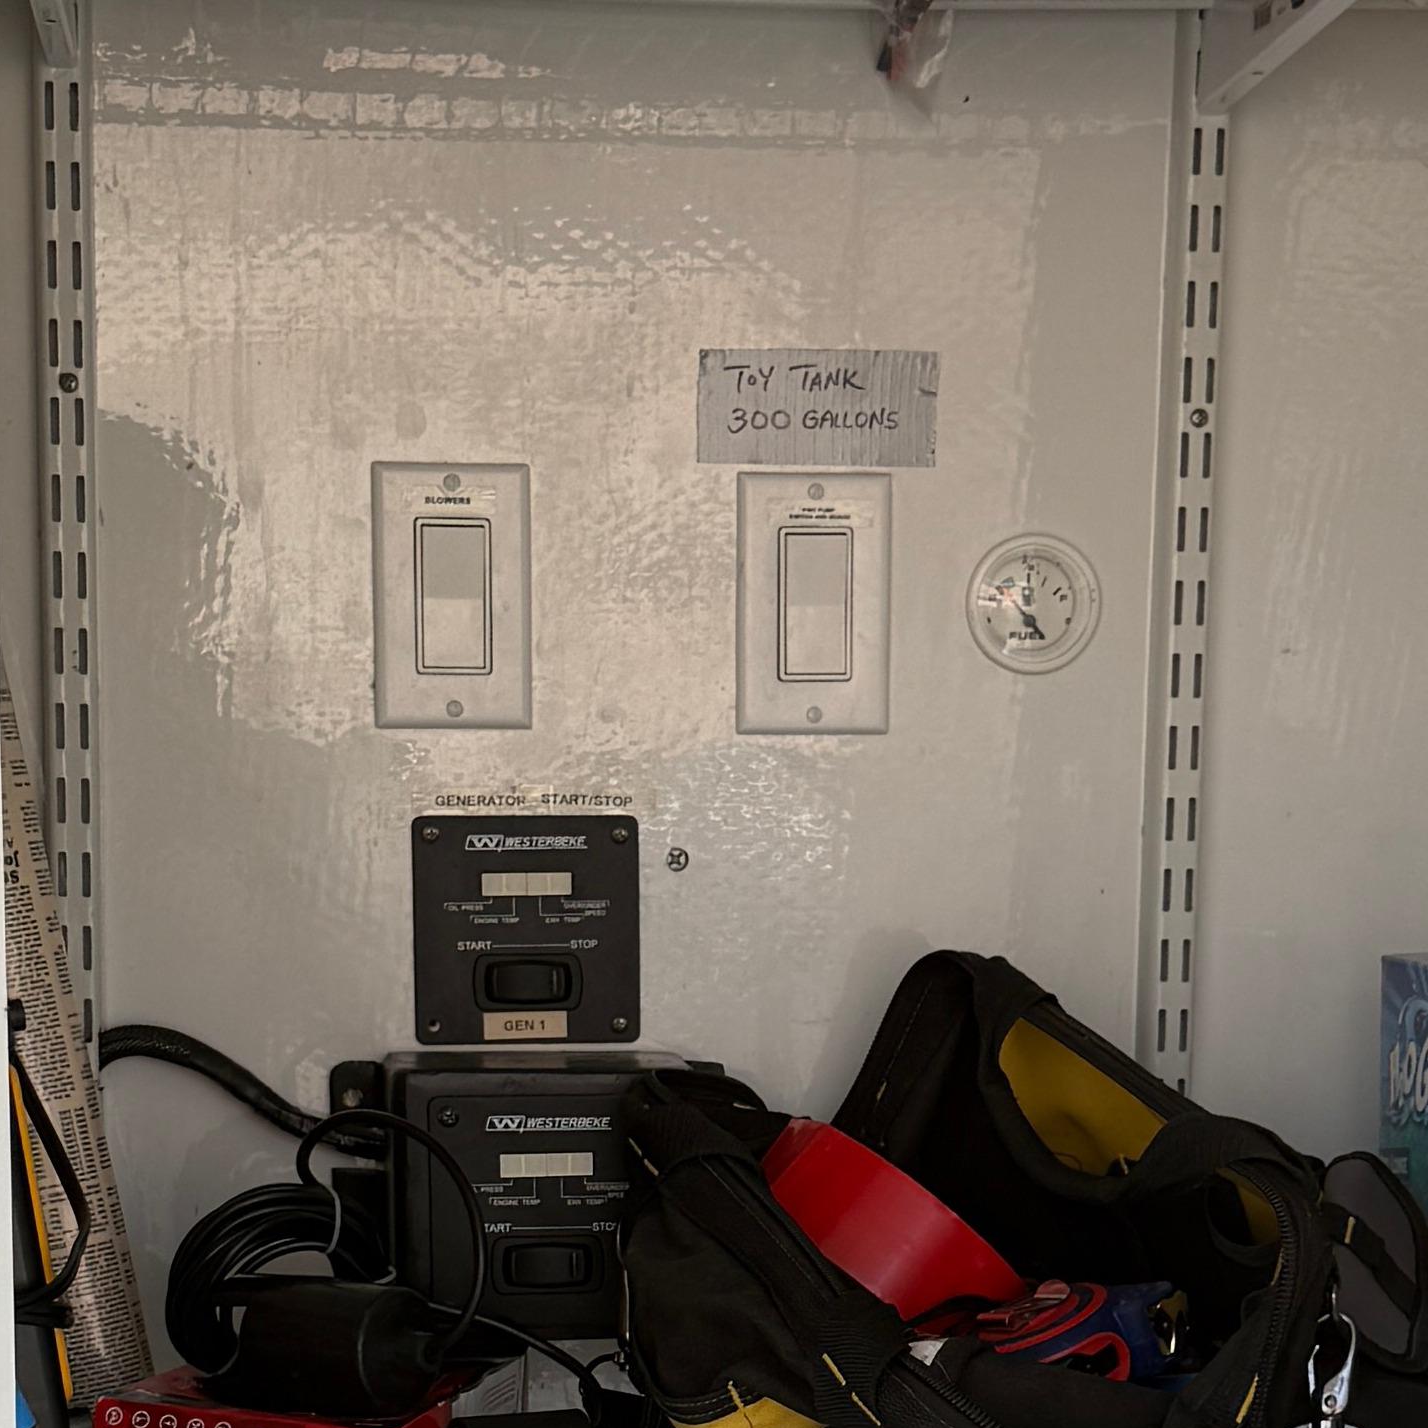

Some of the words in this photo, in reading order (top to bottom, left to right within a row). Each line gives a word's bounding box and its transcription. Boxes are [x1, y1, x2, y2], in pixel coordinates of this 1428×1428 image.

[788, 363, 866, 392] TANK
[726, 407, 791, 434] 300
[801, 408, 901, 431] GALLONS
[424, 496, 471, 505] BLOWERS
[1008, 631, 1046, 641] FUE
[435, 795, 526, 806] GENERATOR
[540, 793, 633, 807] START/STOP
[504, 835, 588, 848] WESTERBEKE
[457, 940, 492, 951] START
[569, 939, 598, 950] STOP
[503, 1019, 535, 1032] GEN
[539, 1019, 546, 1032] 1
[525, 1115, 612, 1129] WESTERBEKE
[484, 1223, 513, 1233] TART
